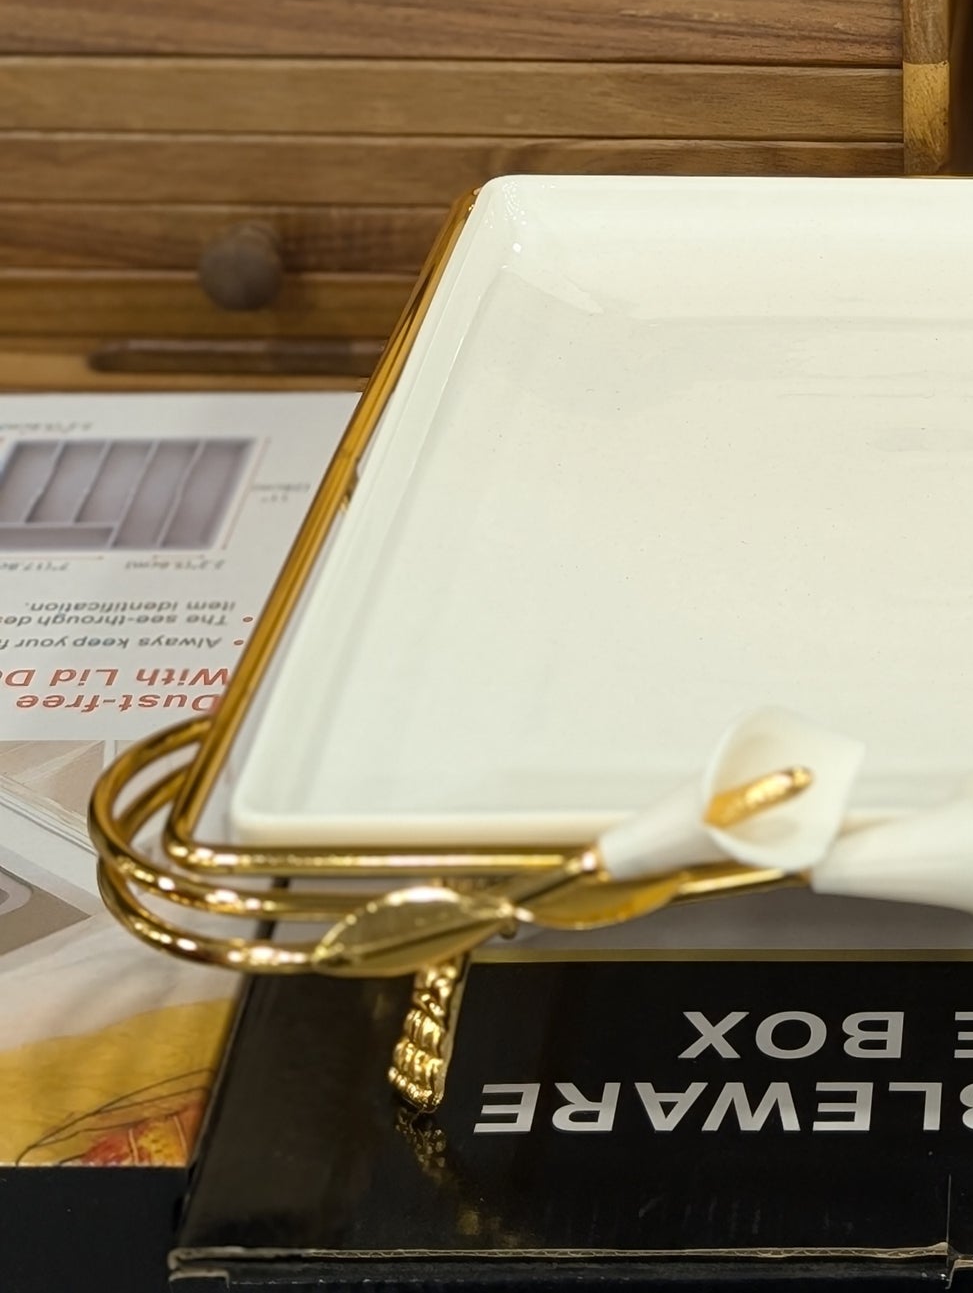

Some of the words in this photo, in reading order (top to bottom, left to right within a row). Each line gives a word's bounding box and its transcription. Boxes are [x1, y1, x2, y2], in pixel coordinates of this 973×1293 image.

[25, 601, 178, 614] identification.
[186, 601, 236, 612] item
[38, 613, 178, 626] see-through
[186, 614, 228, 626] The
[15, 635, 69, 648] your
[73, 637, 130, 649] keep
[138, 635, 222, 649] Always
[0, 669, 36, 686] D
[49, 669, 119, 686] Lid
[136, 668, 230, 686] With
[16, 694, 222, 712] Dust-free
[679, 1010, 907, 1060] BOX
